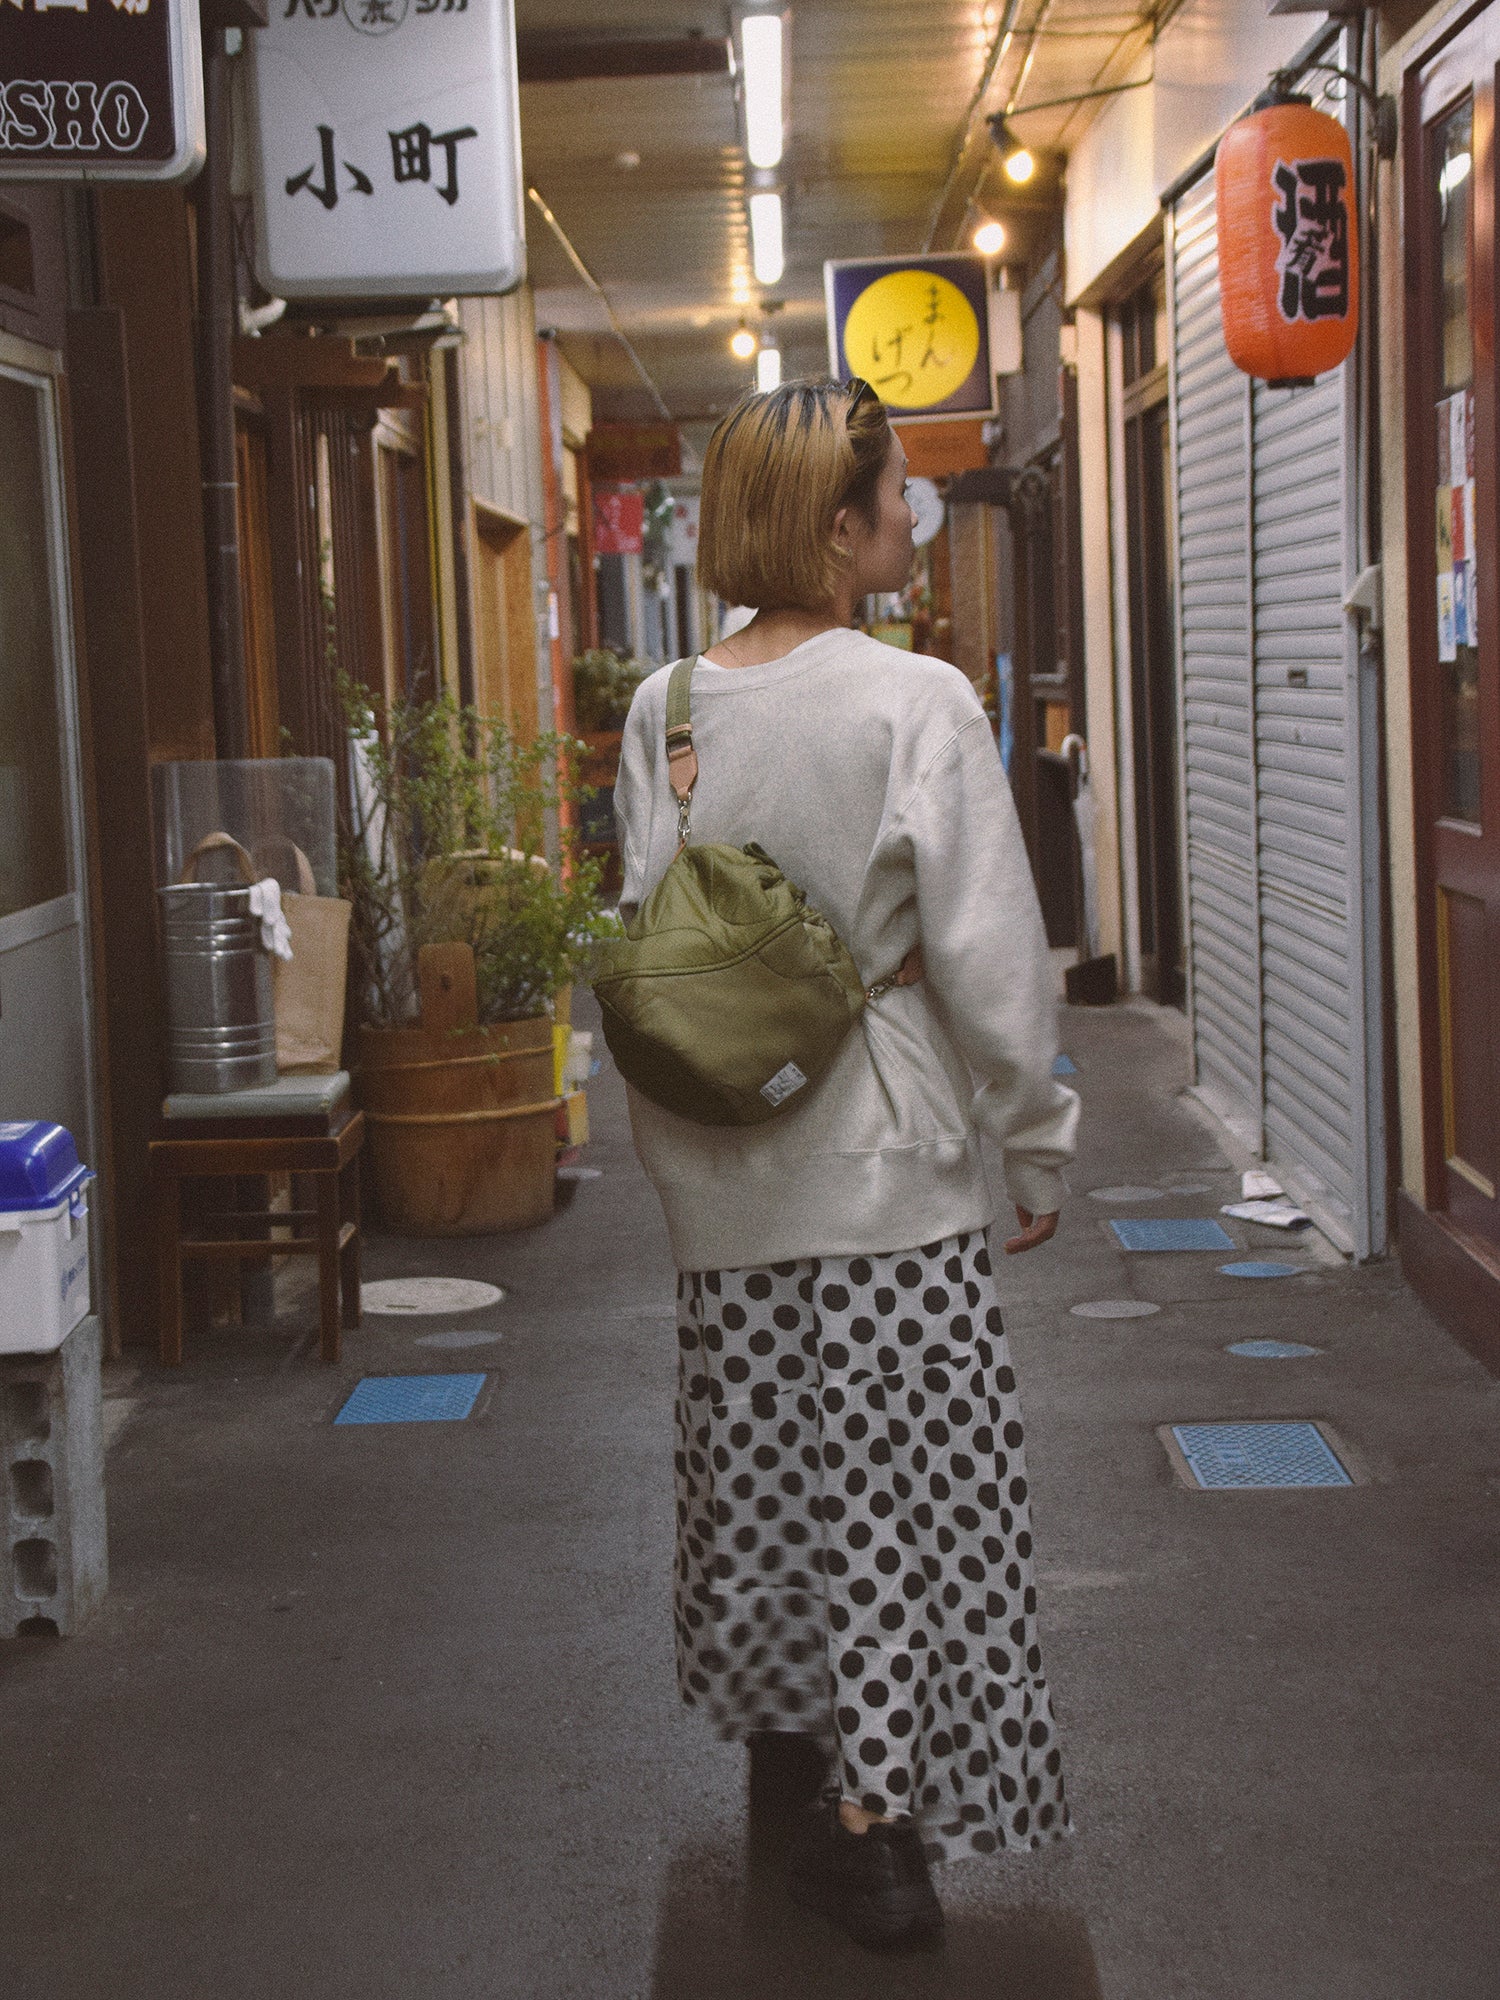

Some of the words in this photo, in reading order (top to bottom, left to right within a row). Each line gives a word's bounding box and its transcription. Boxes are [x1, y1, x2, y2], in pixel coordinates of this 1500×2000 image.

[0, 79, 149, 151] SHO
[285, 121, 478, 210] 小町
[1274, 160, 1348, 320] 酒
[870, 324, 914, 394] げつ
[921, 282, 949, 369] まん
